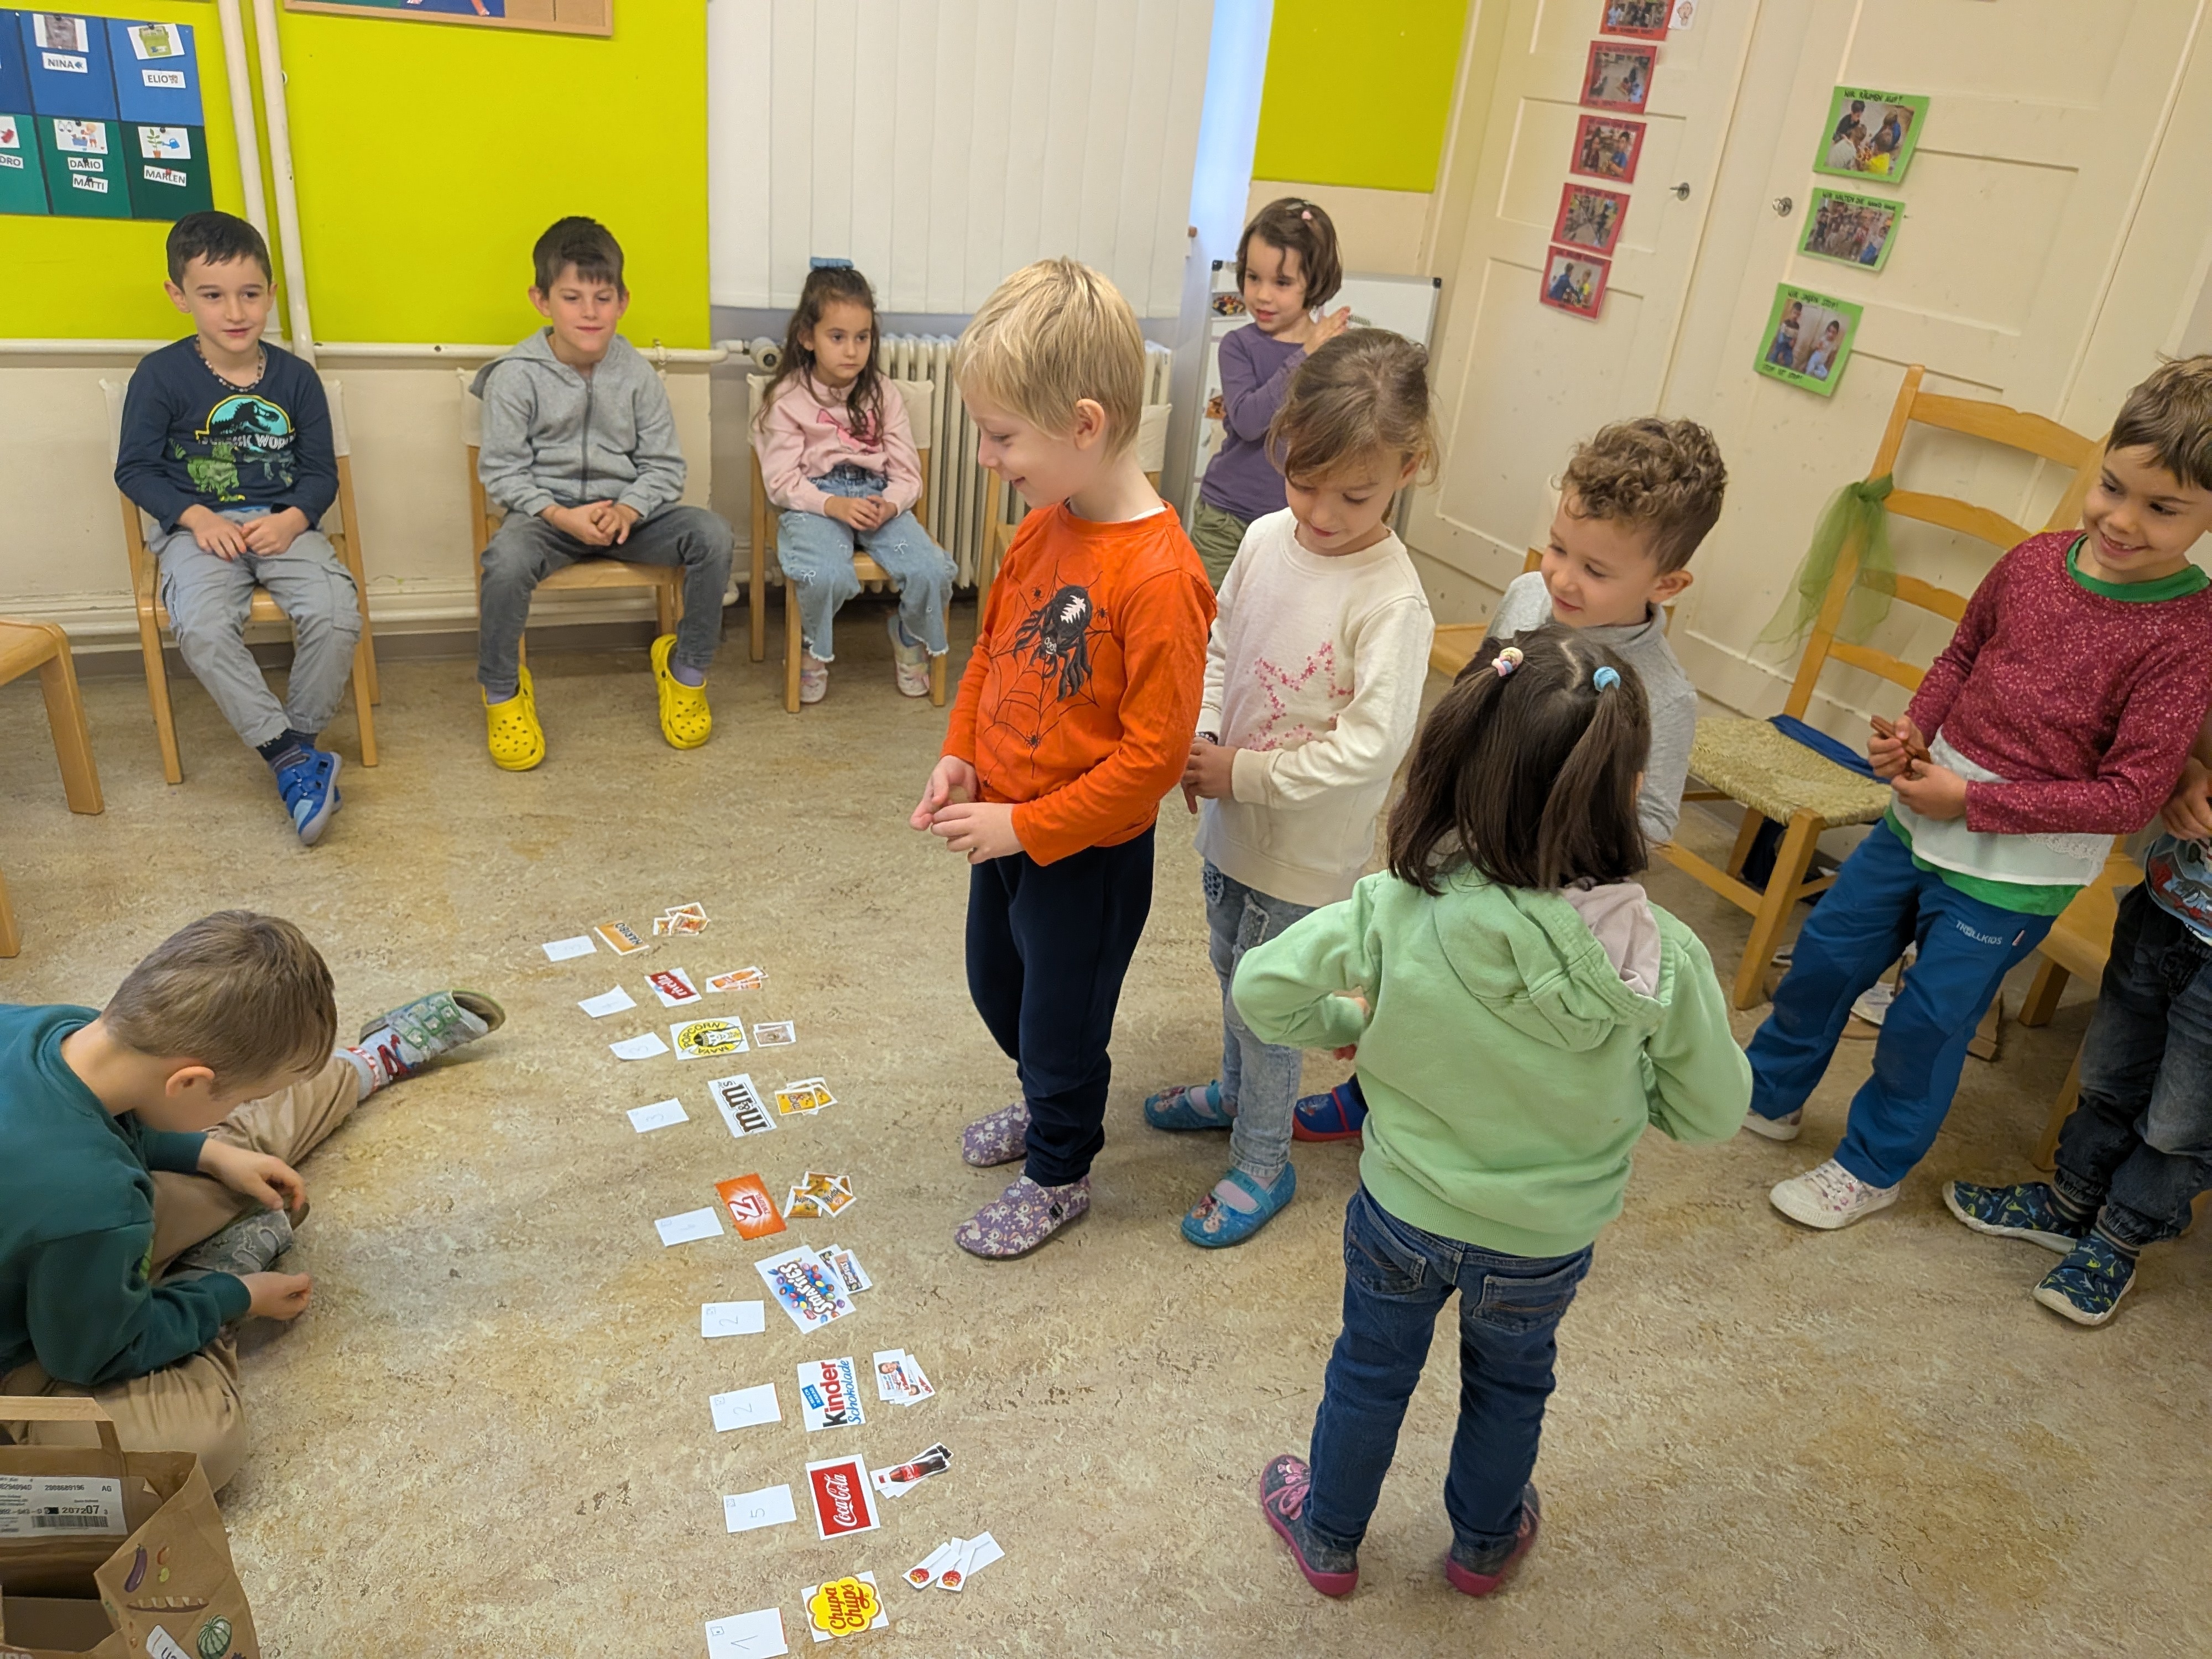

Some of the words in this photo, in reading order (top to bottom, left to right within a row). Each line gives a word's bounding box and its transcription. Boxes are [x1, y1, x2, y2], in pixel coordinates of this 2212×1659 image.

[48, 58, 75, 69] NINA
[148, 75, 169, 84] ELIO
[70, 159, 101, 169] DARIO
[145, 169, 185, 184] MARLEN
[74, 177, 105, 190] MATTI
[1956, 920, 2002, 945] TROLLKIDS
[682, 1022, 720, 1048] POPCORN
[698, 1046, 729, 1055] MAYA
[719, 1316, 738, 1326] 2
[837, 1360, 862, 1425] Schokolade
[733, 1403, 752, 1415] 2
[750, 1508, 765, 1518] 5
[825, 1587, 846, 1630] Chupa
[841, 1583, 870, 1627] Chups
